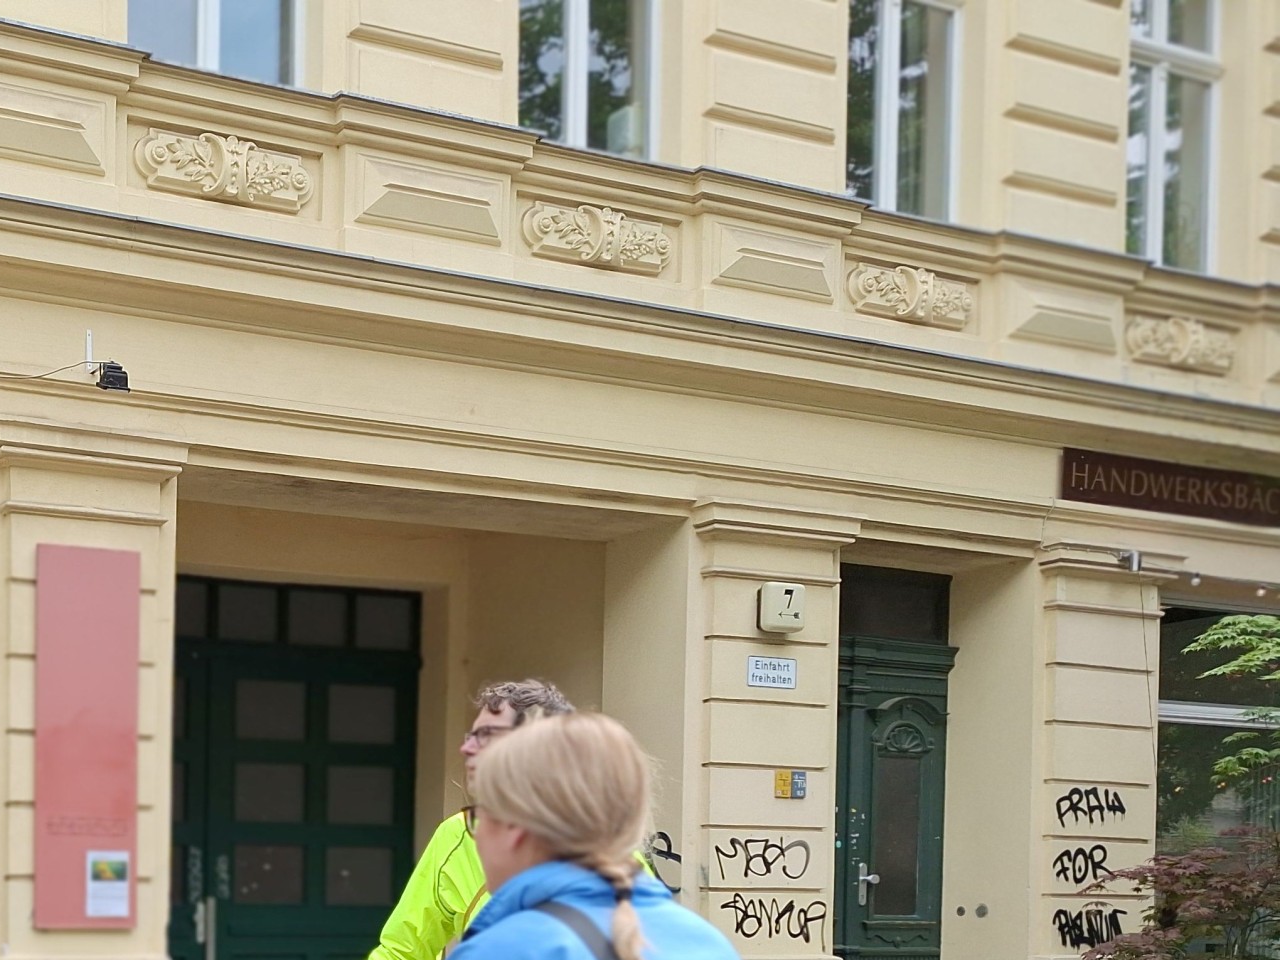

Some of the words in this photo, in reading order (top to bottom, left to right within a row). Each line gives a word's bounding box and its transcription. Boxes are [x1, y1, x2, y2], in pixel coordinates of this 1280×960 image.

[784, 588, 795, 610] 7
[754, 659, 791, 673] Einfahrt
[751, 672, 793, 685] freihalten
[1052, 844, 1116, 885] FOR
